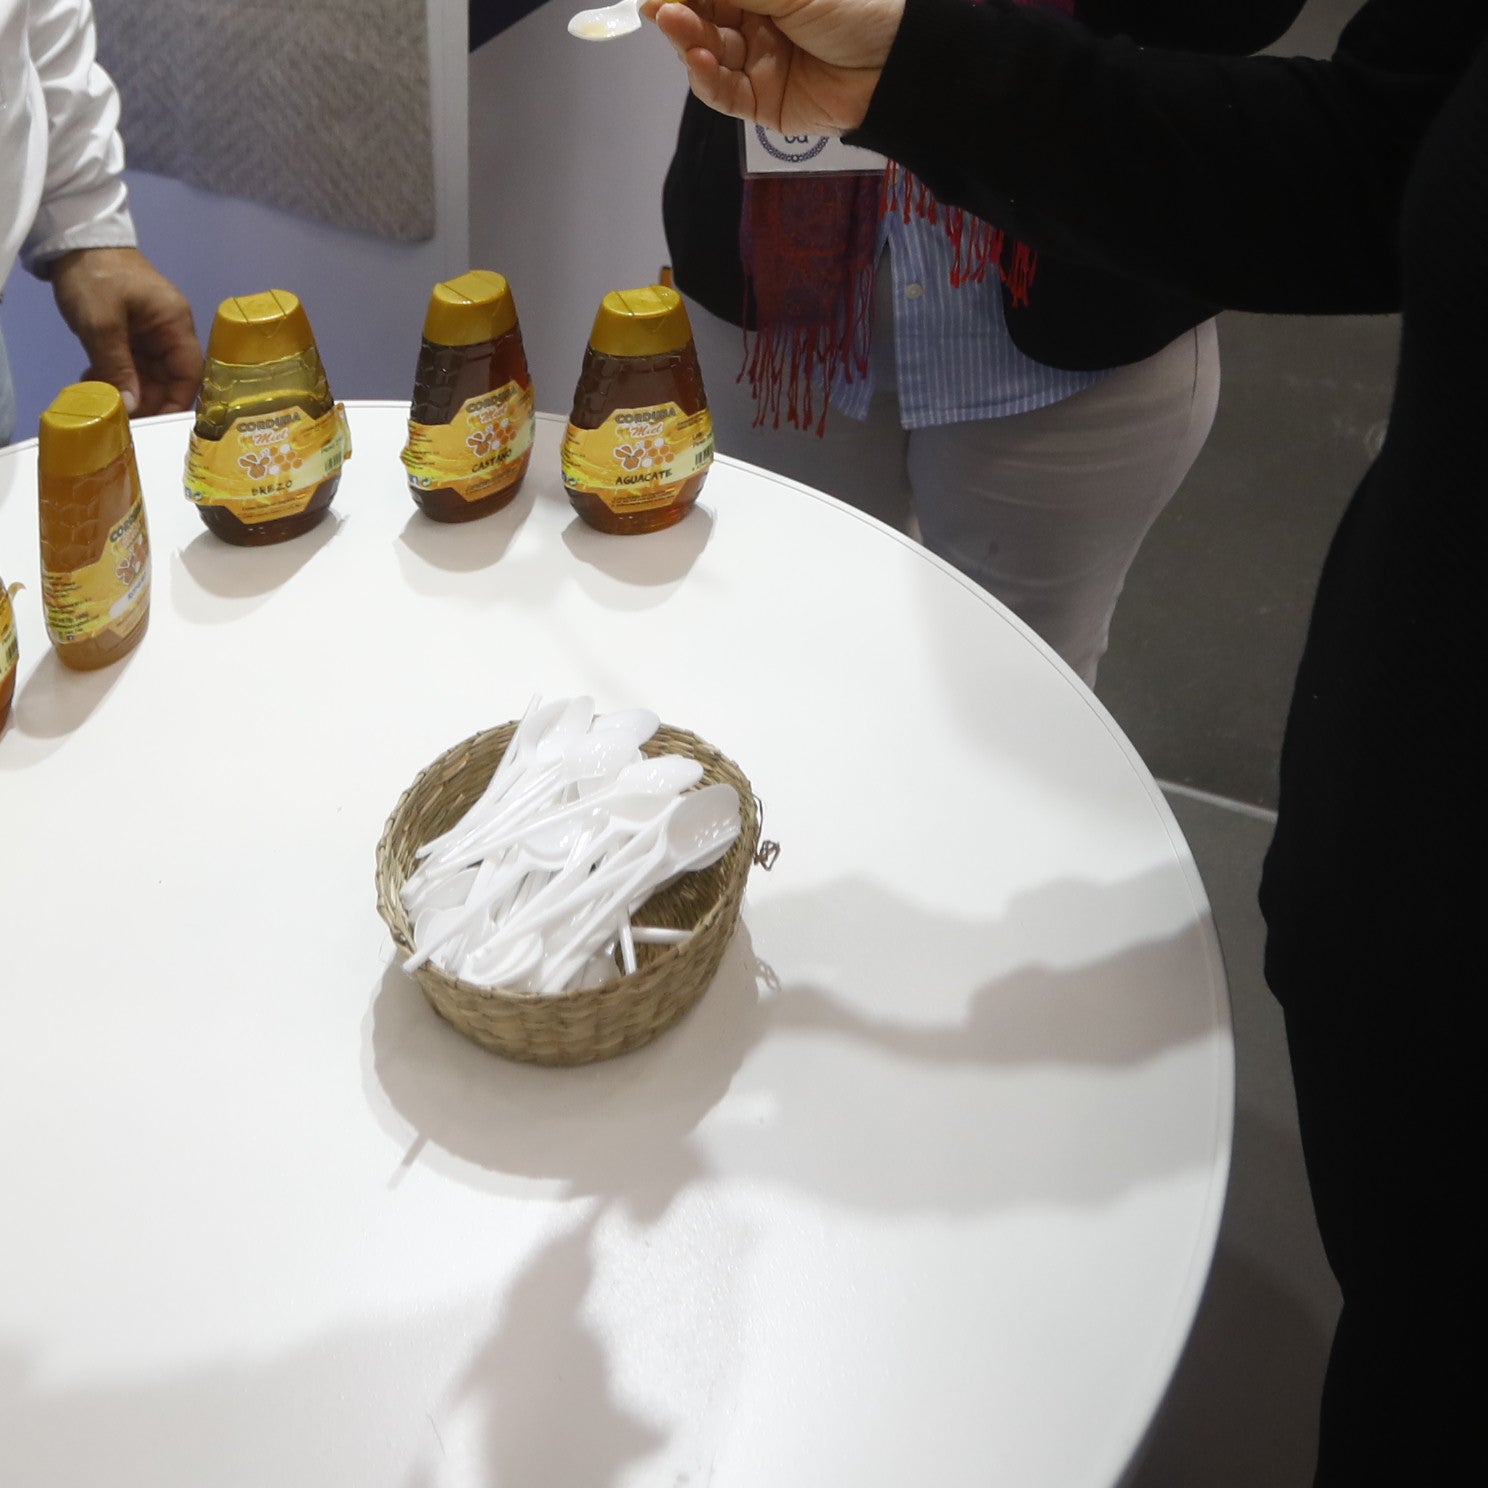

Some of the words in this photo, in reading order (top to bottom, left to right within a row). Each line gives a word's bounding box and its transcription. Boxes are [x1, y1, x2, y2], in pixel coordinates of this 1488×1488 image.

[236, 411, 302, 433] CORDUBA
[614, 407, 677, 425] CORDUBA
[255, 427, 288, 446] Miel
[631, 423, 664, 438] Miel
[615, 468, 673, 486] AGUACATE
[251, 479, 293, 497] BREZO
